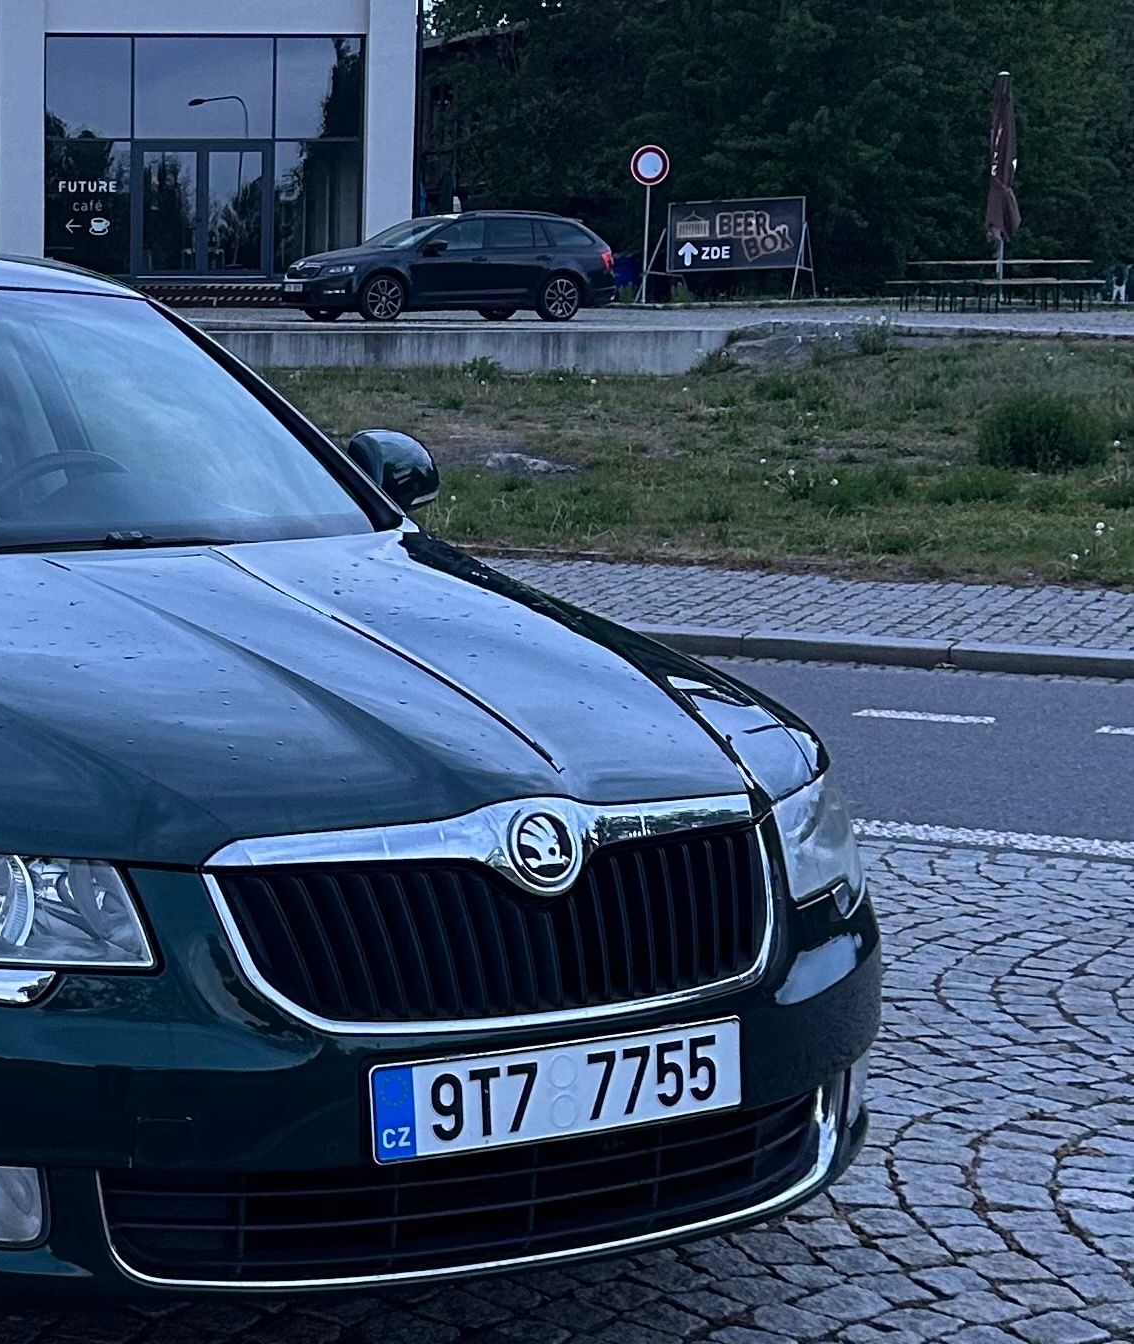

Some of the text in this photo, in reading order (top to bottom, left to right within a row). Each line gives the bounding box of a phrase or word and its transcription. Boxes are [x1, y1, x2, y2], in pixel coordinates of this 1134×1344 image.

[58, 180, 117, 193] FUTURE
[72, 199, 103, 212] café
[717, 211, 769, 237] BEER
[701, 246, 731, 260] ZDE
[743, 226, 792, 259] BOX
[430, 1034, 717, 1142] 9T7 7755
[382, 1126, 411, 1149] CZ
